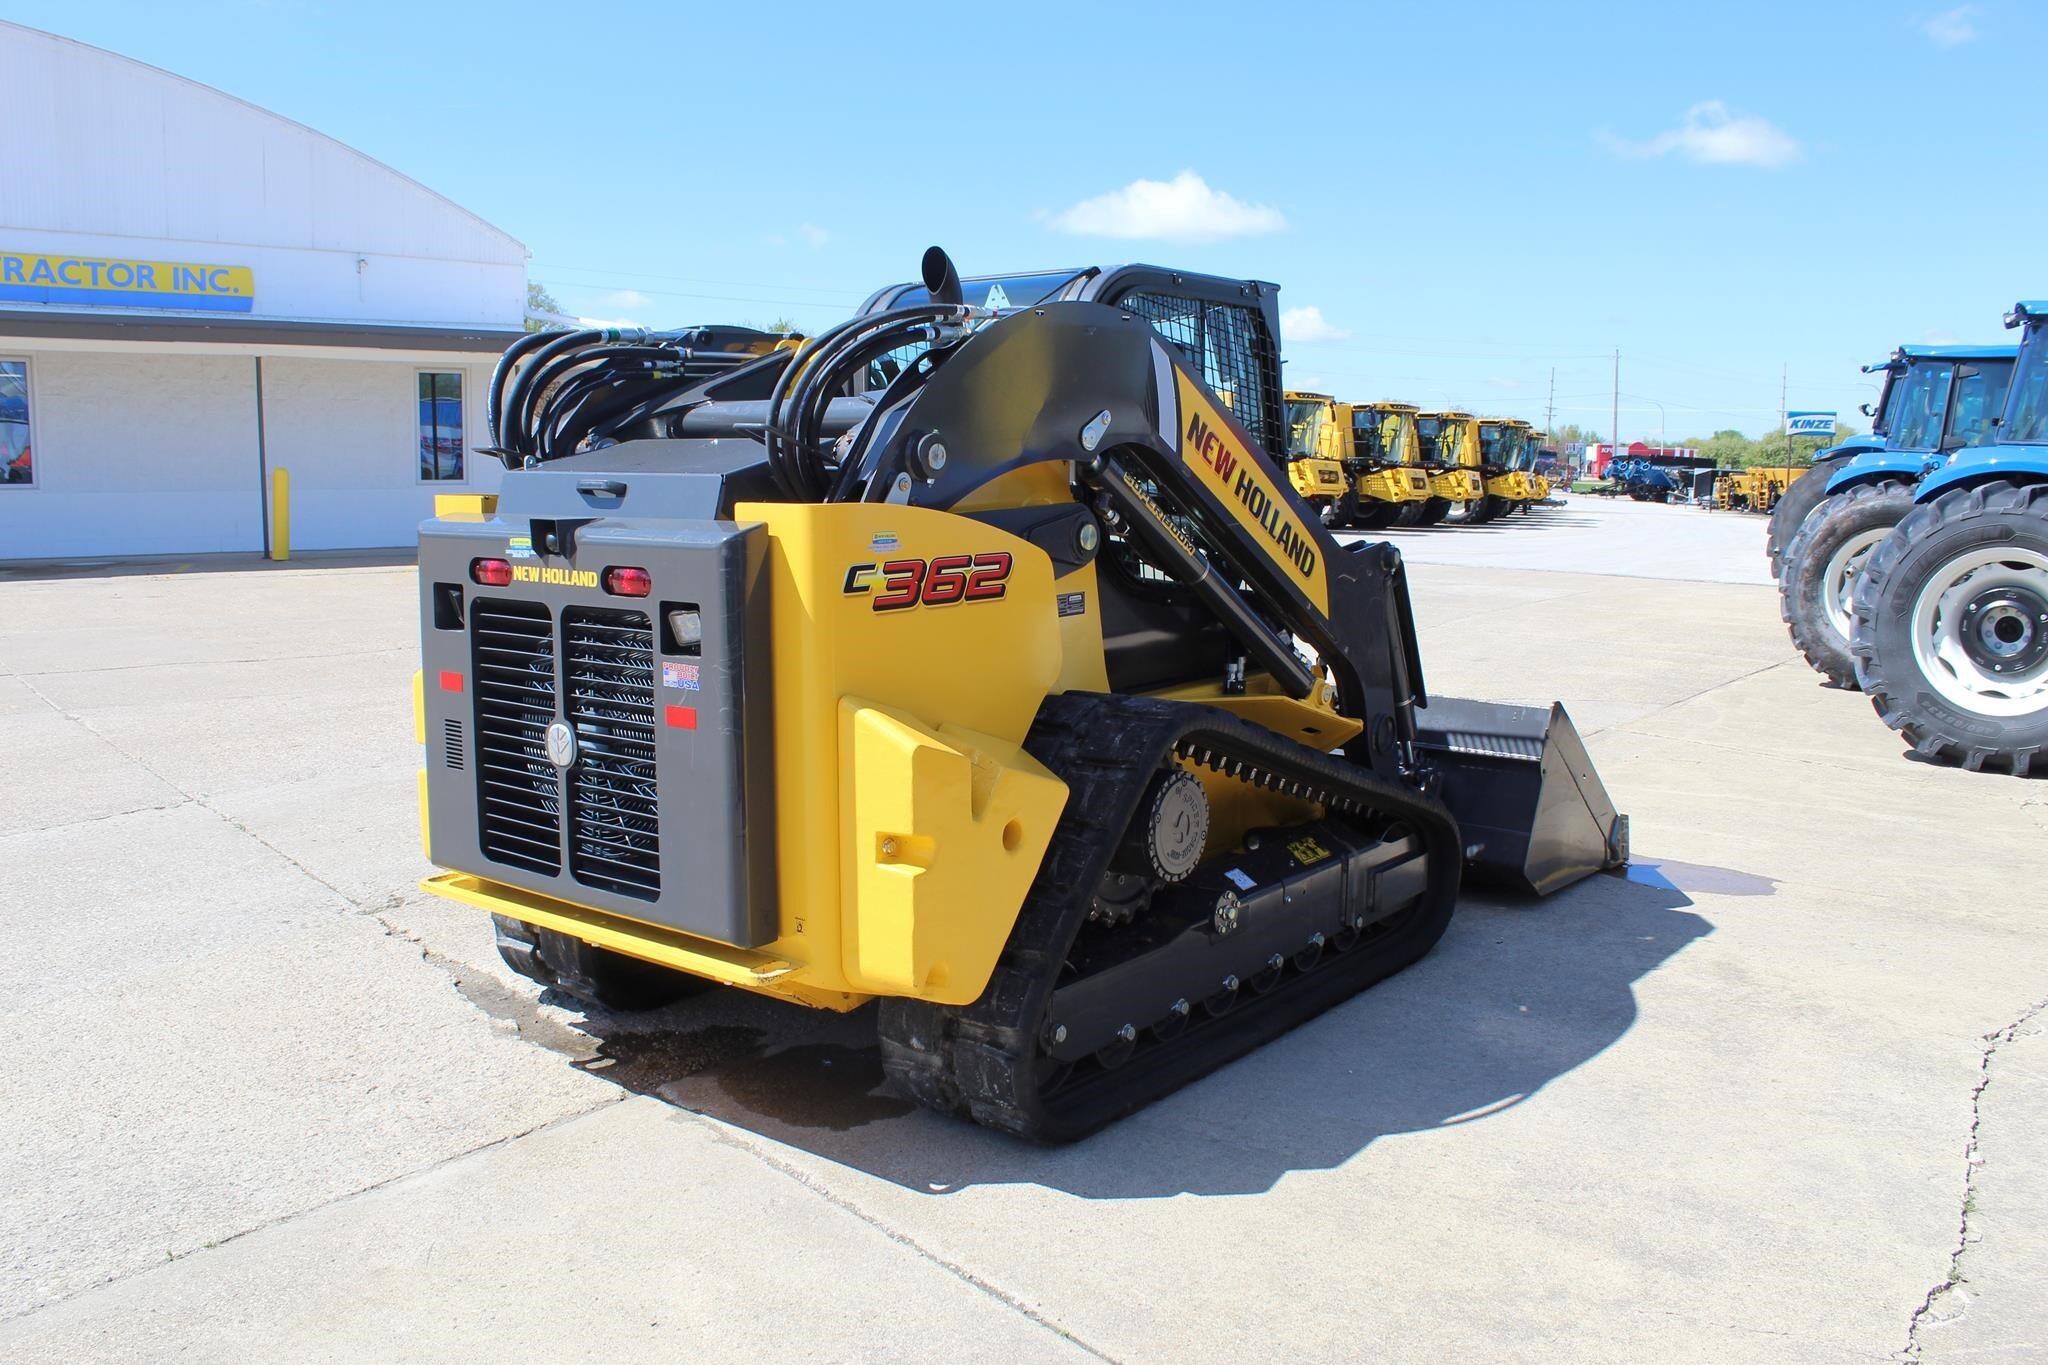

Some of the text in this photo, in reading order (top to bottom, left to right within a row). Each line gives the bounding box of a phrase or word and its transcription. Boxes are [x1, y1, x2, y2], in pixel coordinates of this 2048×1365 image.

[0, 256, 241, 293] RACTOR INC.
[1789, 418, 1834, 430] KINZE
[1186, 411, 1316, 579] NEW HOLLAND
[513, 566, 598, 588] NEW HOLLAND
[843, 551, 1014, 613] C362
[677, 679, 699, 690] USA
